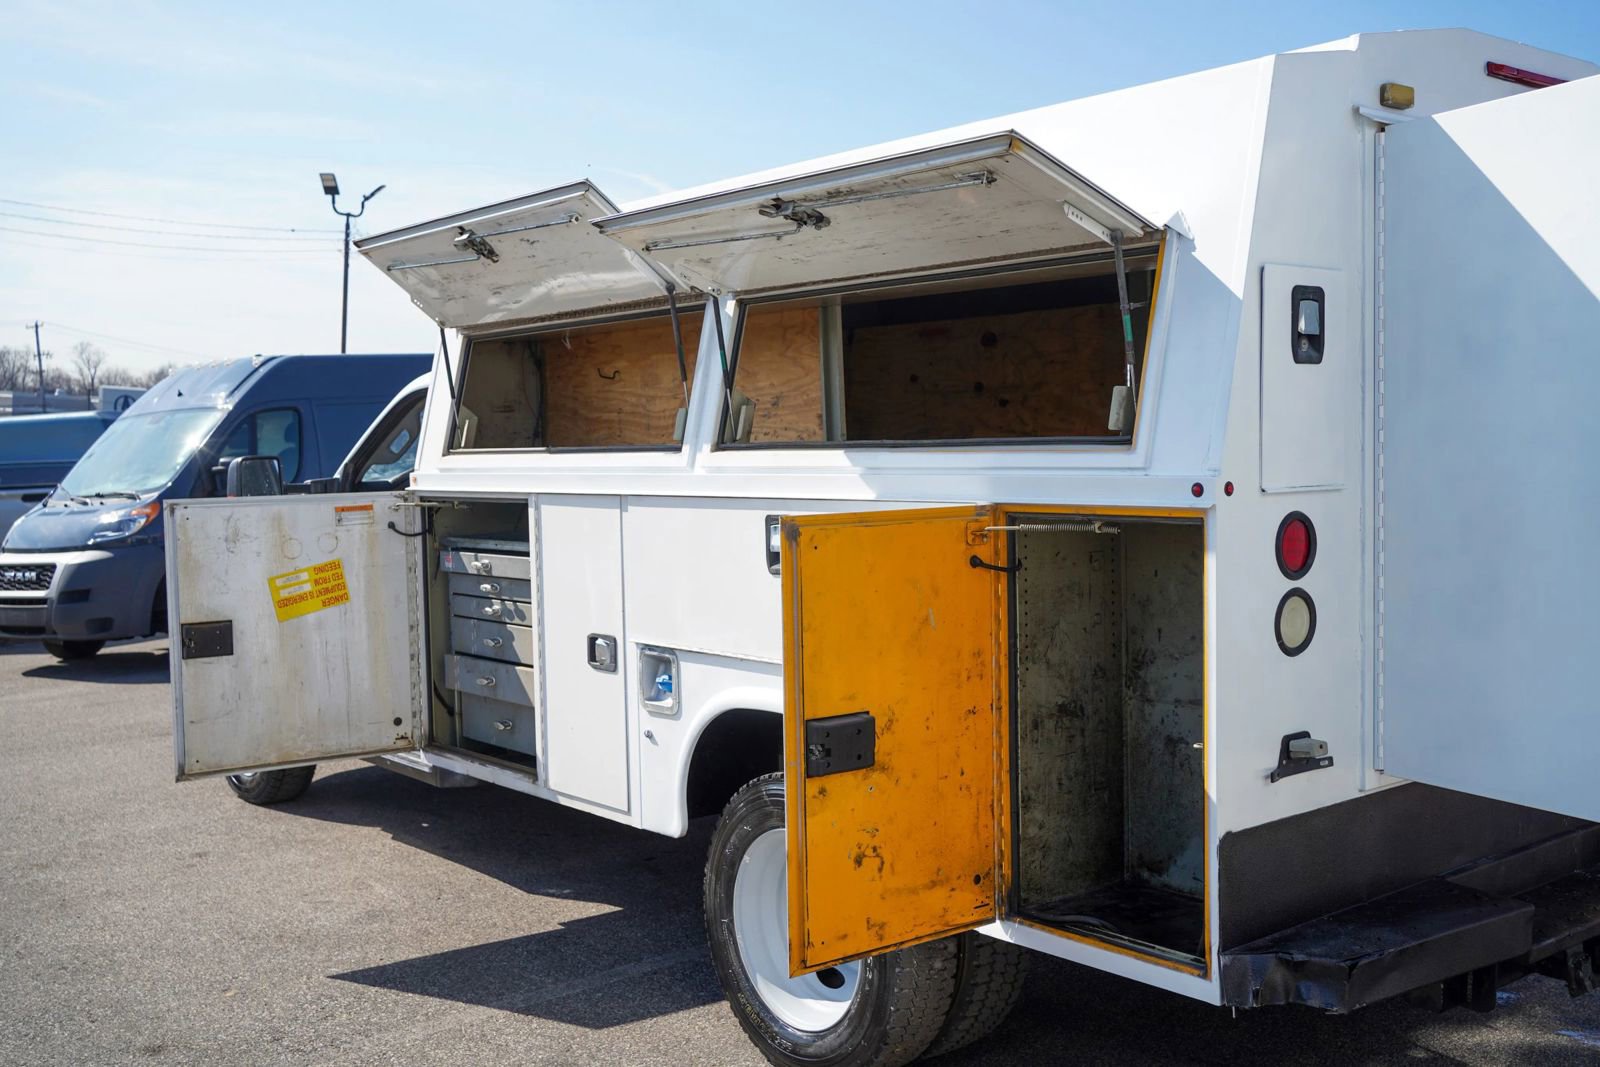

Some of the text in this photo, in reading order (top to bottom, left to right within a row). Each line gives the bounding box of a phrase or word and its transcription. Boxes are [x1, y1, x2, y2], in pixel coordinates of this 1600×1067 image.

[314, 561, 340, 575] FEEDING
[314, 573, 343, 586] FED FROM
[309, 592, 315, 600] IS
[315, 582, 346, 598] EQUIPMENT
[278, 593, 309, 608] ENERGIZED
[322, 592, 348, 607] DANGER
